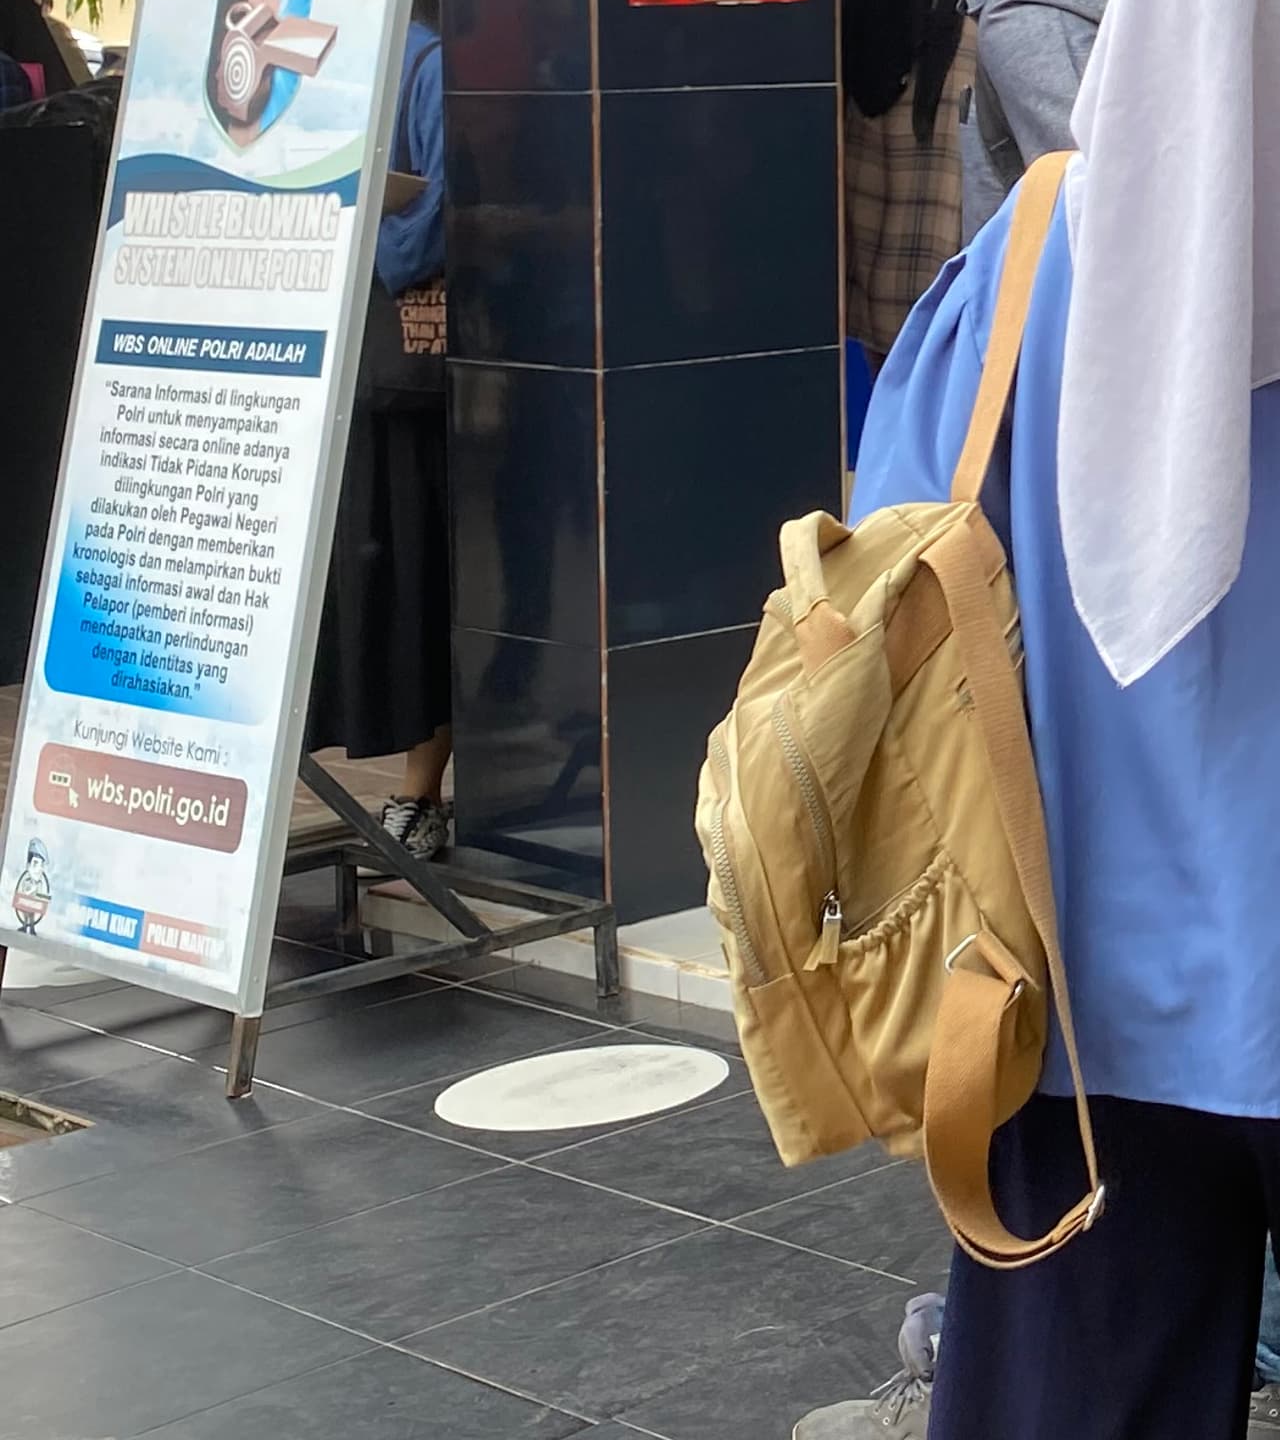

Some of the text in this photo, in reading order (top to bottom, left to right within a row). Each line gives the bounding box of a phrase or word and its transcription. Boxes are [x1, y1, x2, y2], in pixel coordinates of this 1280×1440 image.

[123, 192, 341, 241] WHISTLE BLOWING
[114, 245, 333, 291] SYSTEM ONLINE POLRI
[113, 333, 305, 363] WBS ONLINE POLRI ADALAH
[155, 384, 211, 403] Informasi
[215, 389, 226, 405] di
[229, 390, 300, 414] lingkungan
[117, 404, 278, 437] Polri untuk menyampaikan
[100, 427, 289, 463] informasi secara online adanya
[100, 450, 281, 487] indikasi Tidak Pidana Korupsi
[114, 477, 258, 510] dilingkungan Polri yang
[91, 497, 277, 537] dilakukan oleh Pegawai Negeri
[85, 522, 274, 558] pada Polri dengan memberikan
[72, 542, 281, 584] kronologis dan melampirkan bukti
[75, 567, 269, 608] sebagai informasi awal dan Hak
[83, 591, 254, 636] Pelapor (pemberi informasi)
[80, 617, 248, 660] mendapatkan perlindungan
[91, 642, 227, 683] dengan identitas yang
[74, 720, 128, 750] Kunjungi
[132, 731, 183, 757] Website
[187, 740, 221, 764] Kami
[87, 775, 230, 827] wbs.polri.go.id
[147, 923, 178, 948] POLRI
